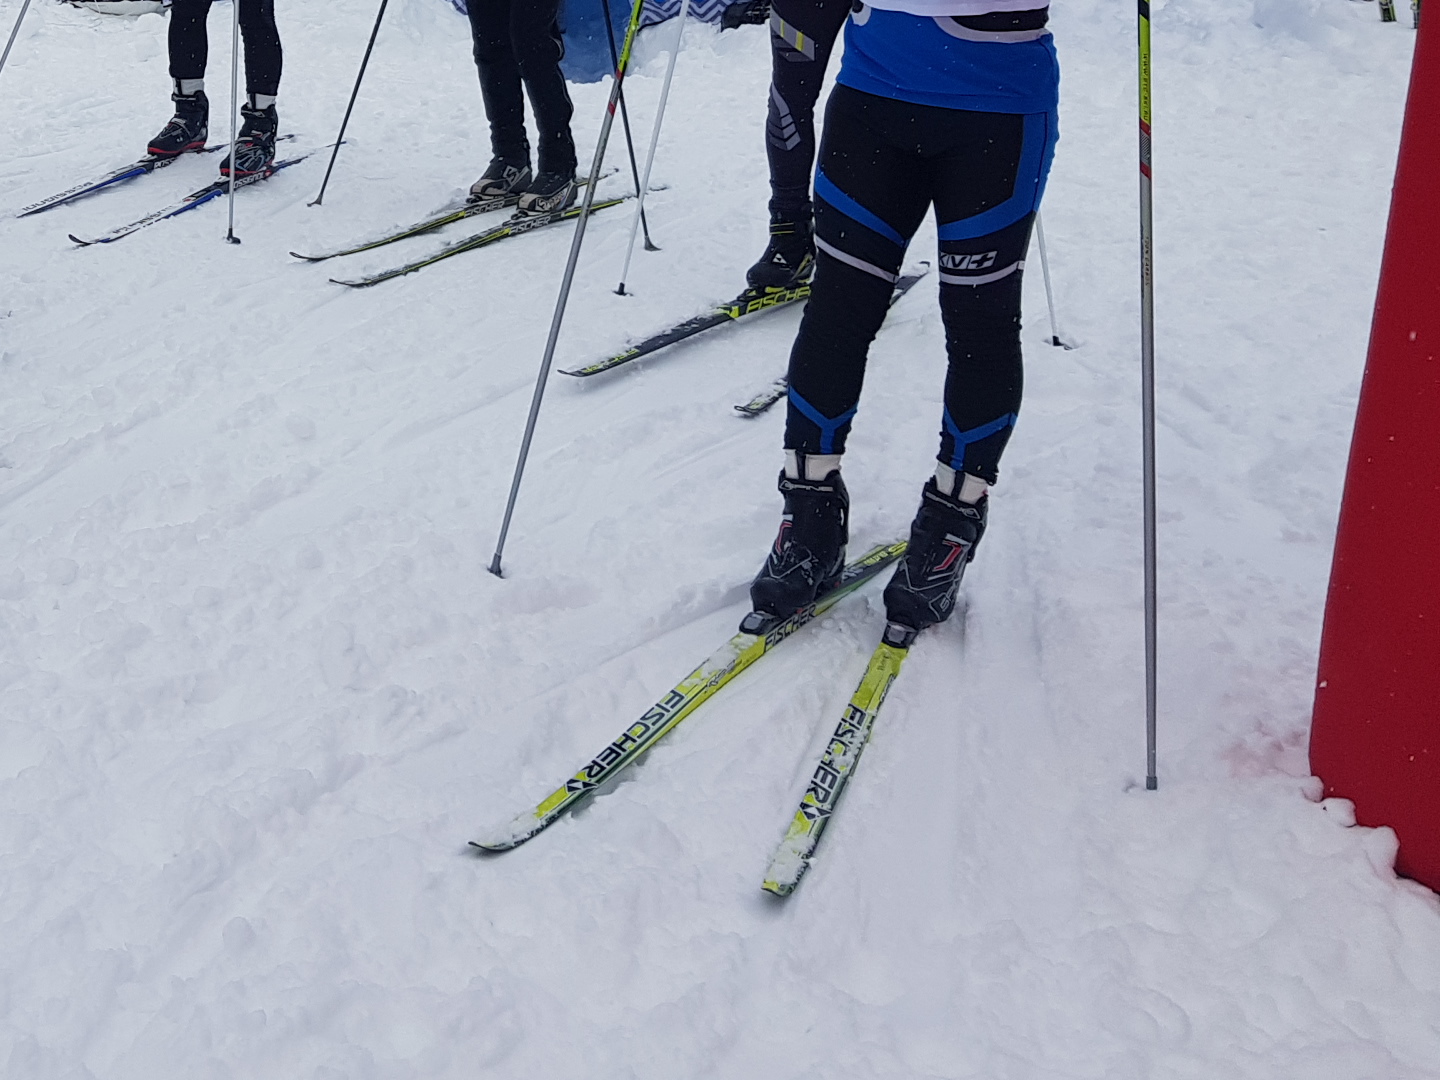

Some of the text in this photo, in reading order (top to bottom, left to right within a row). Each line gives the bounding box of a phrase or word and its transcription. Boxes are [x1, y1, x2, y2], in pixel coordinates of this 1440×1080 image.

[464, 200, 505, 218] FISCHER
[508, 217, 551, 235] FISCHER
[746, 286, 811, 314] FISCHE
[764, 603, 817, 653] FISCHER
[581, 689, 685, 779] FISCHER
